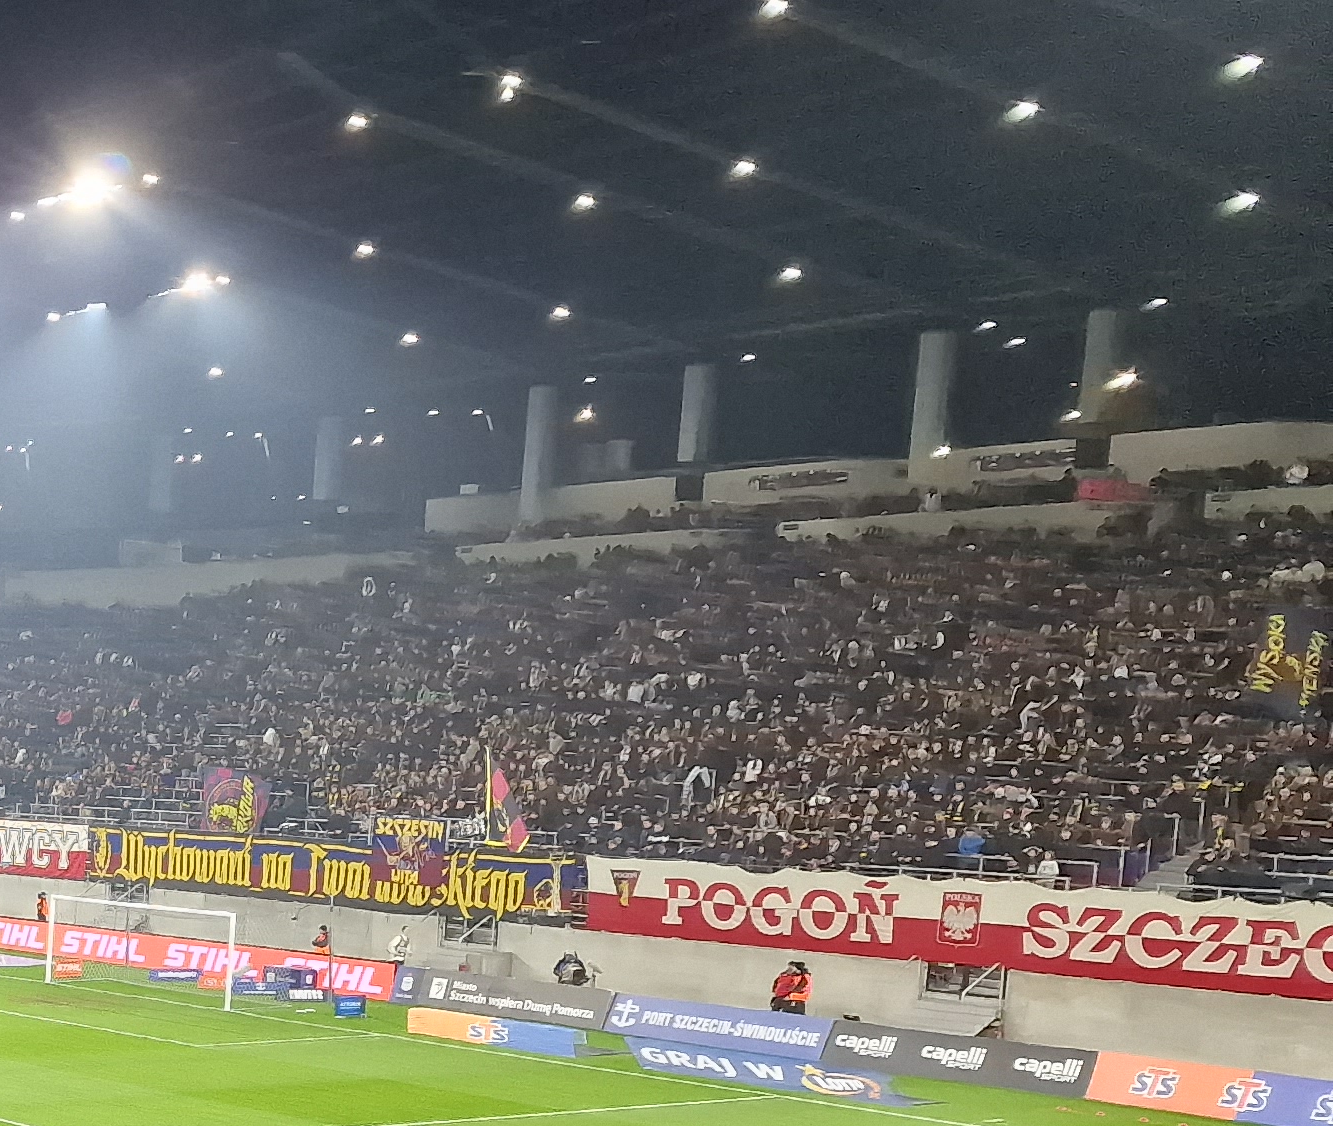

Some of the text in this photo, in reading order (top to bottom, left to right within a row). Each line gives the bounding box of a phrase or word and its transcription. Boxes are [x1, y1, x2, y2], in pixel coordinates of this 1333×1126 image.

[661, 878, 900, 944] POGOŃ
[61, 930, 147, 964] STIHL
[452, 980, 478, 991] Miasto
[449, 989, 595, 1020] Szczecin wspiera Dumę Pomorza
[641, 1010, 672, 1028] PORT
[466, 1021, 509, 1044] STS
[835, 1034, 898, 1055] capelli
[640, 1047, 737, 1078] GRAJ
[743, 1061, 784, 1082] W
[920, 1044, 988, 1068] capelli
[947, 1060, 983, 1071] SPORT
[1013, 1056, 1084, 1080] capelli
[1041, 1073, 1078, 1084] SPORT
[1130, 1066, 1181, 1099] STS
[1218, 1078, 1272, 1112] STS
